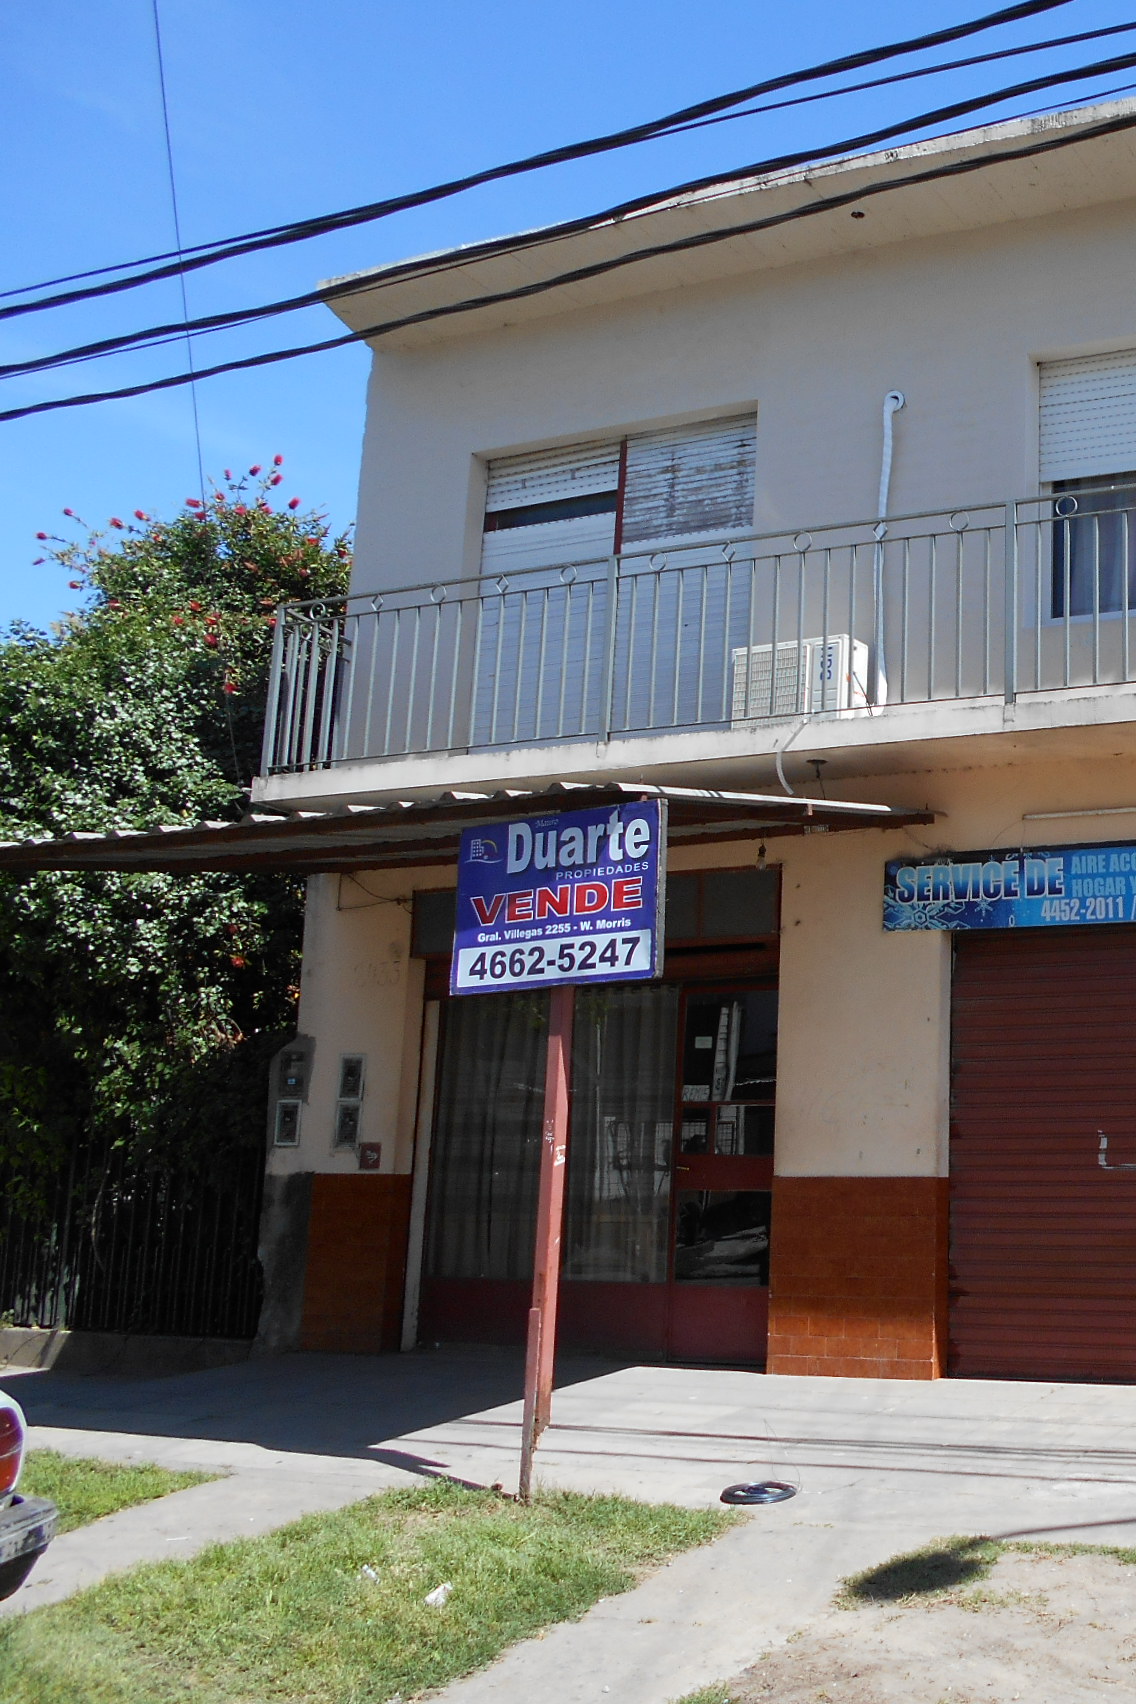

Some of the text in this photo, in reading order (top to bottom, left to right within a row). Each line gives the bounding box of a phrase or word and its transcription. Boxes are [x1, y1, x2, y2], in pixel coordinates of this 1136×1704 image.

[507, 810, 650, 874] Duarte
[556, 861, 649, 880] PROPIEDADES
[1071, 855, 1106, 874] AIRE
[896, 857, 1065, 904] SERVICE DE
[1072, 876, 1126, 898] HOGAR
[470, 876, 643, 926] VENDE
[1041, 896, 1124, 921] 4452-2011
[477, 932, 501, 943] Gral.
[504, 927, 543, 940] Villegas
[545, 923, 571, 934] 2255
[580, 921, 593, 931] W.
[596, 917, 631, 930] Morris
[469, 936, 640, 980] 4662-5247
